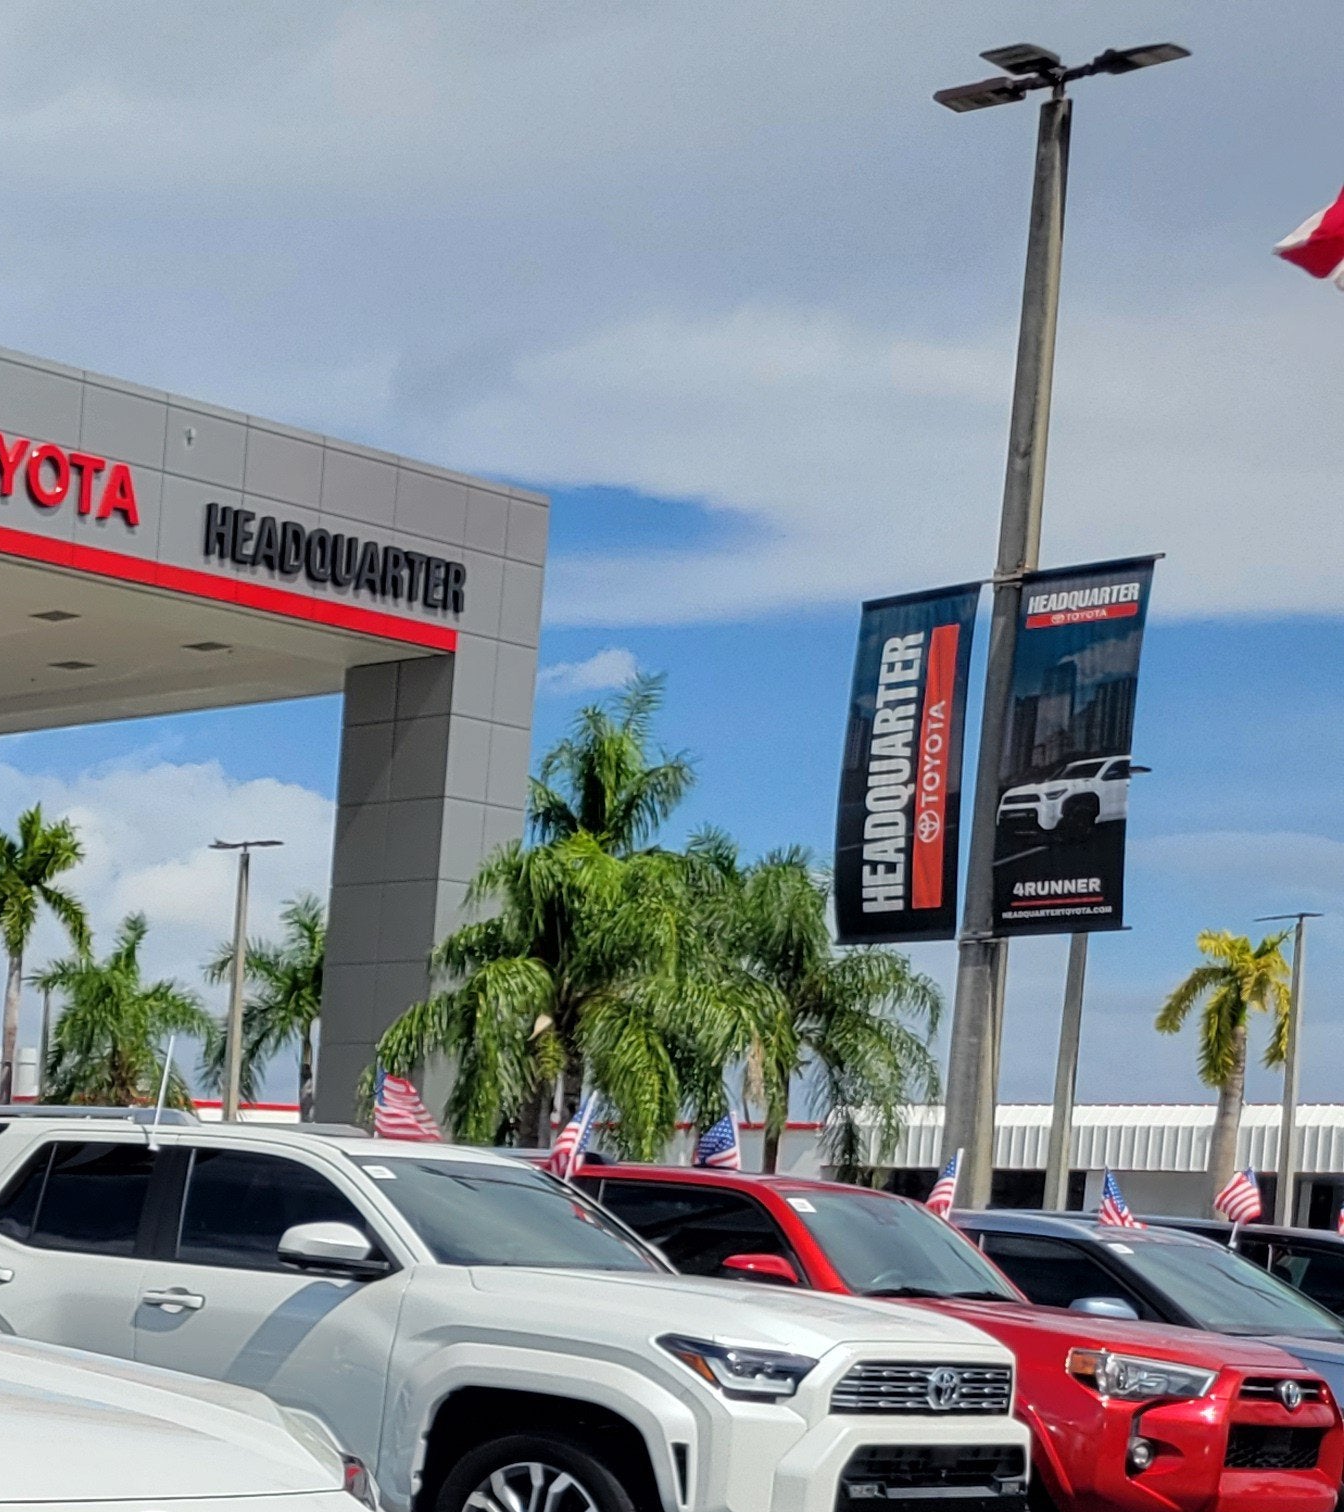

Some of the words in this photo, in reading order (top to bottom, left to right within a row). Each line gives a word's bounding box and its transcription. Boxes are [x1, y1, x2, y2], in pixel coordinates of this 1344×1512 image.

[203, 502, 467, 613] HEADQUARTER
[1026, 582, 1141, 615] HEADQUARTER
[1066, 608, 1107, 621] TOYOTA
[920, 701, 946, 808] TOYOTA
[862, 631, 925, 914] HEADQUARTER
[1012, 877, 1102, 897] 4RUNNER
[1001, 905, 1113, 919] HEADQUARTERTOYOTA.COM
